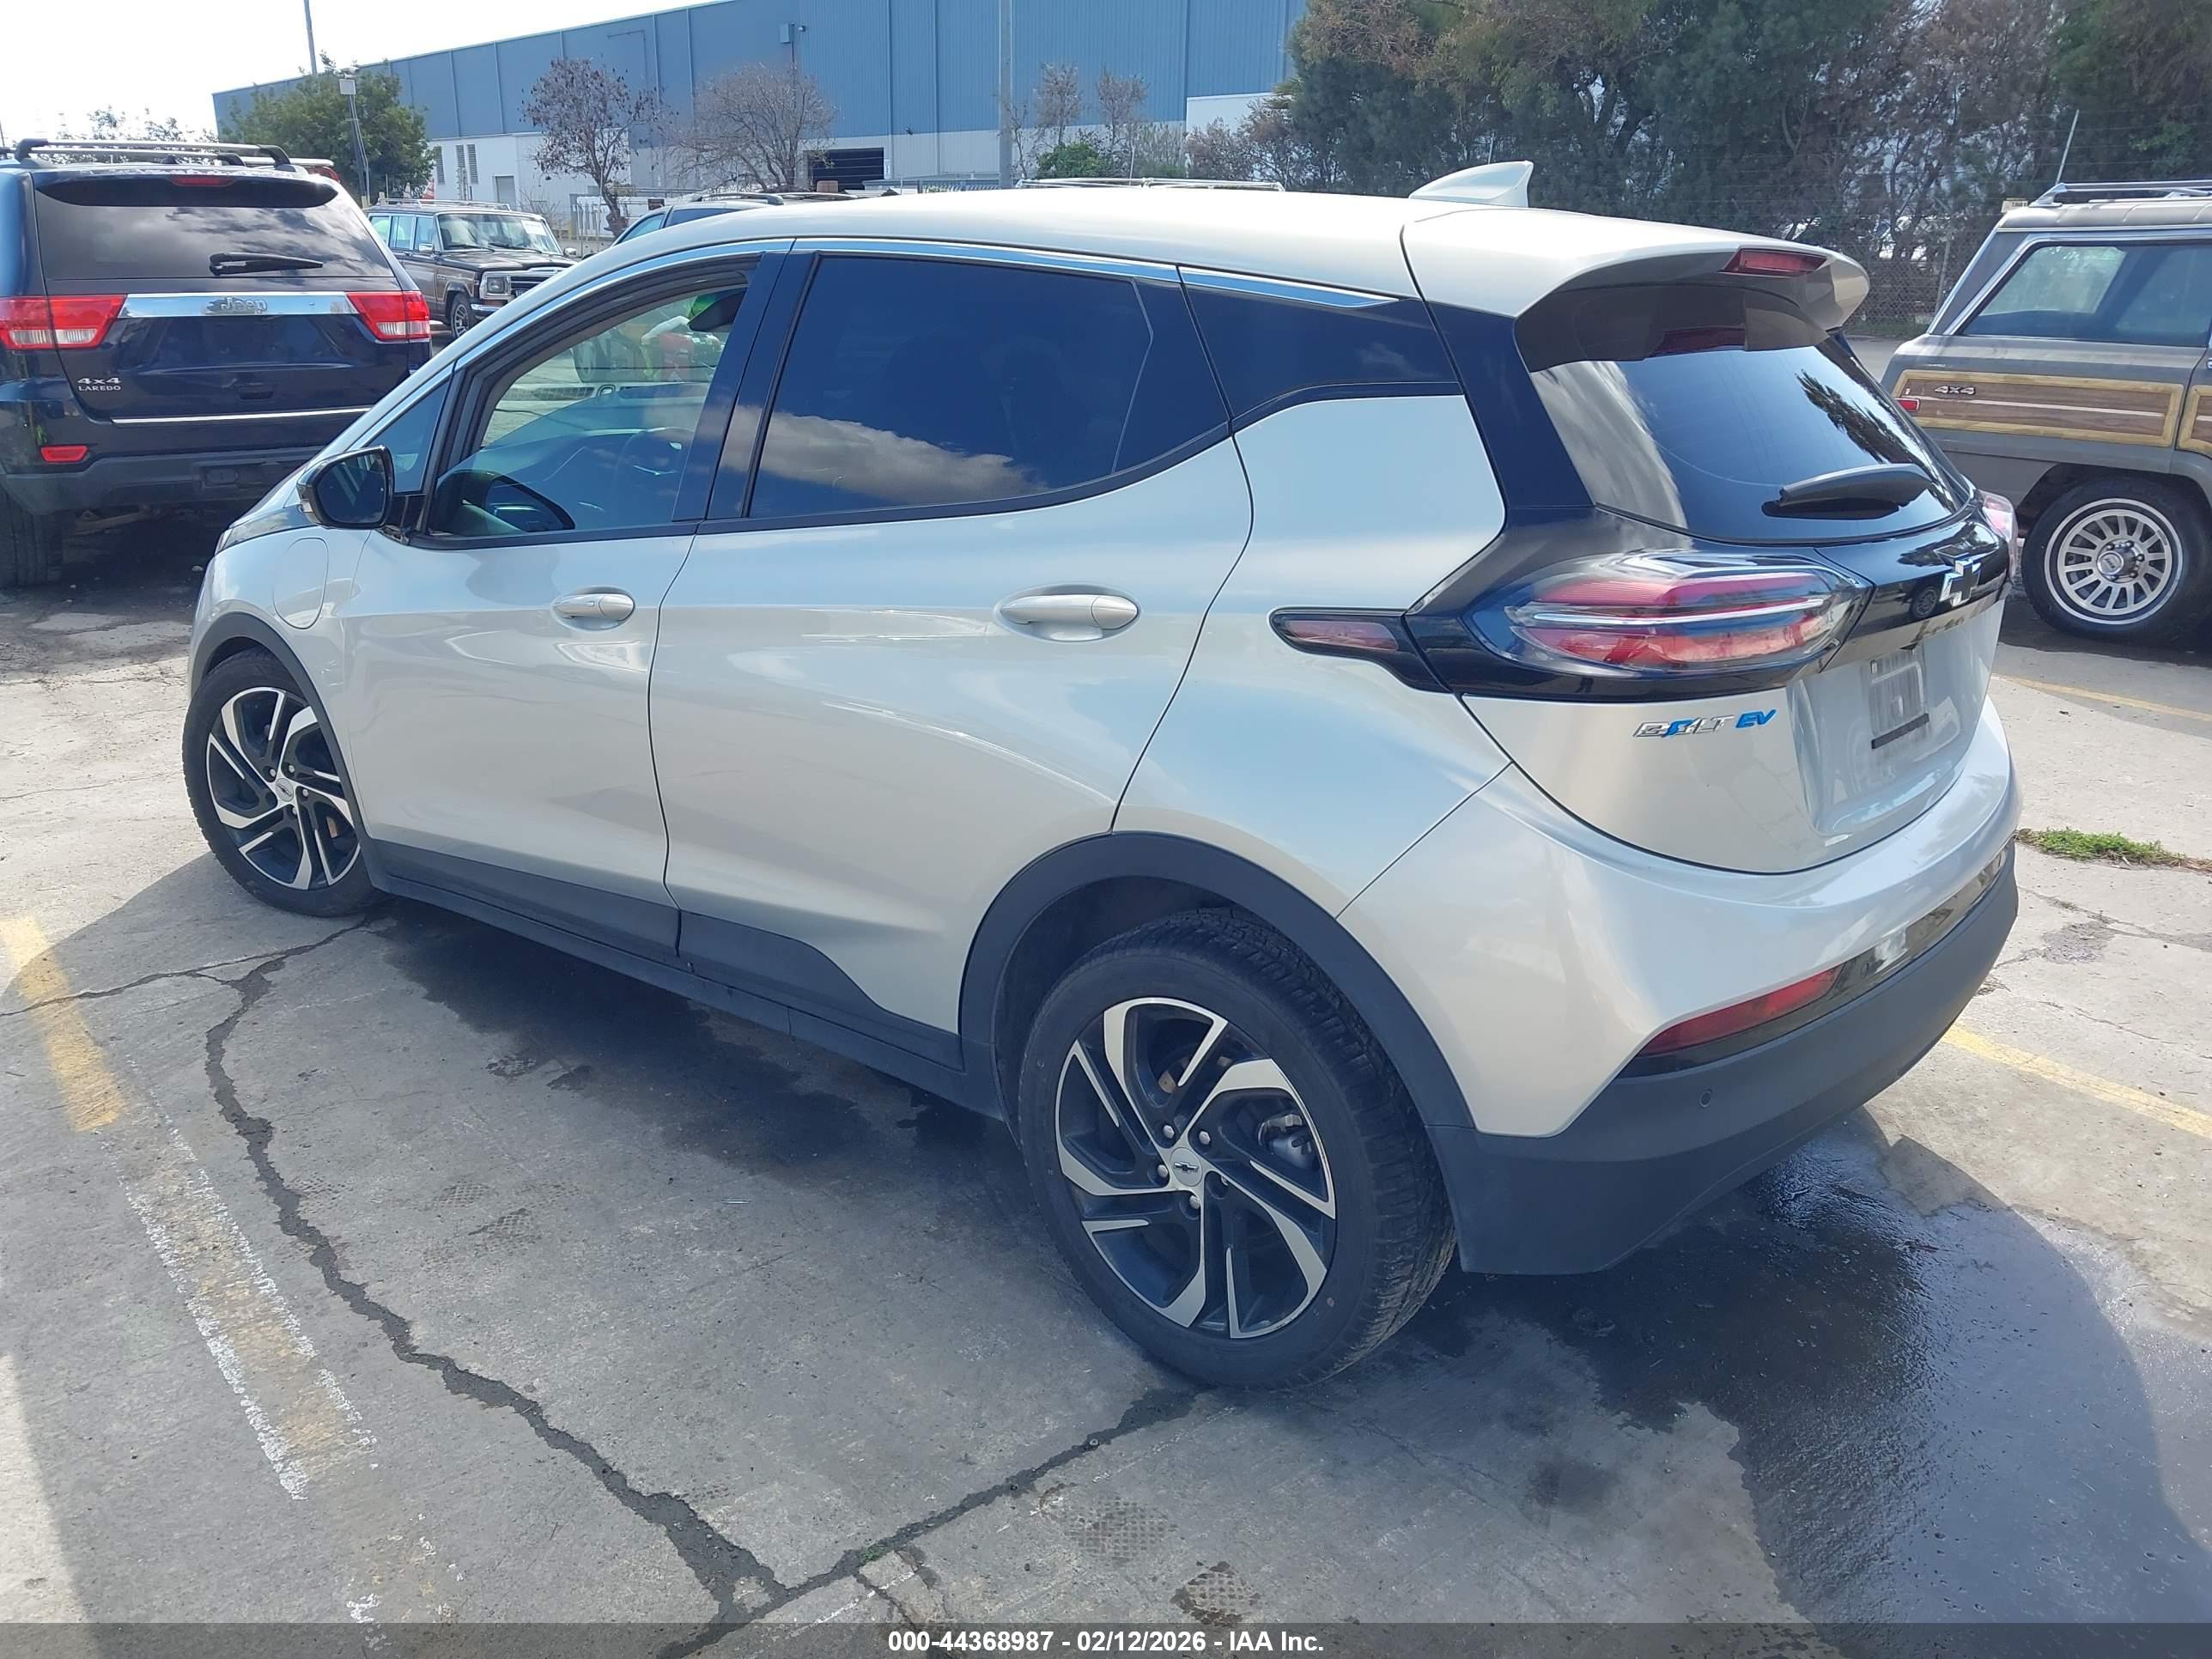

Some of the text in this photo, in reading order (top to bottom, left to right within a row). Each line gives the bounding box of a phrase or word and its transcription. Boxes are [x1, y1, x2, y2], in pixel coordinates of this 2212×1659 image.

[220, 296, 268, 315] Jeep
[1934, 385, 1976, 395] 4x4
[1632, 708, 1778, 738] BOLT EV
